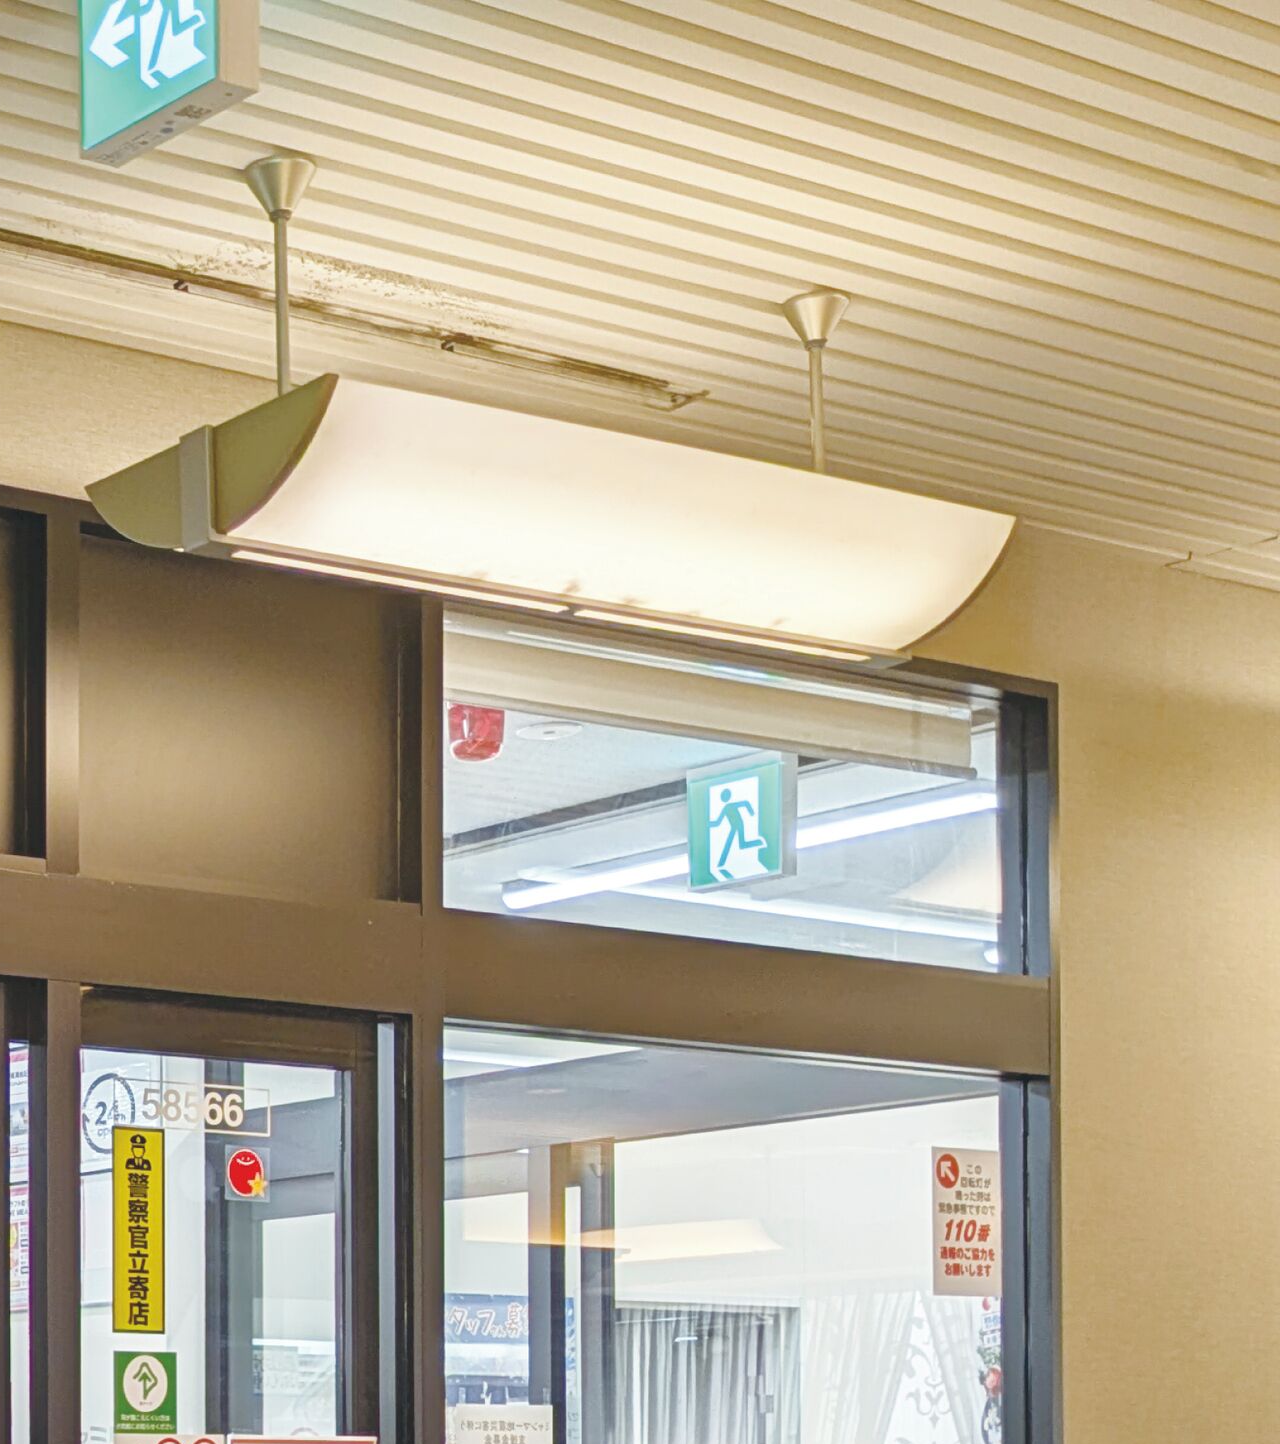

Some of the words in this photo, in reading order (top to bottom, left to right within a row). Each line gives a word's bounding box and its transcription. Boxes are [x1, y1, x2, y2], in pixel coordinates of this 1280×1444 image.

[142, 1087, 244, 1128] 58566
[965, 1164, 982, 1176] この
[959, 1176, 992, 1190] 回転灯が
[943, 1219, 992, 1243] 110番
[126, 1172, 151, 1327] 警察官立寄店
[939, 1246, 996, 1262] 通報のご協力を
[944, 1263, 992, 1278] お願いします
[447, 1302, 529, 1339] タッフさん募
